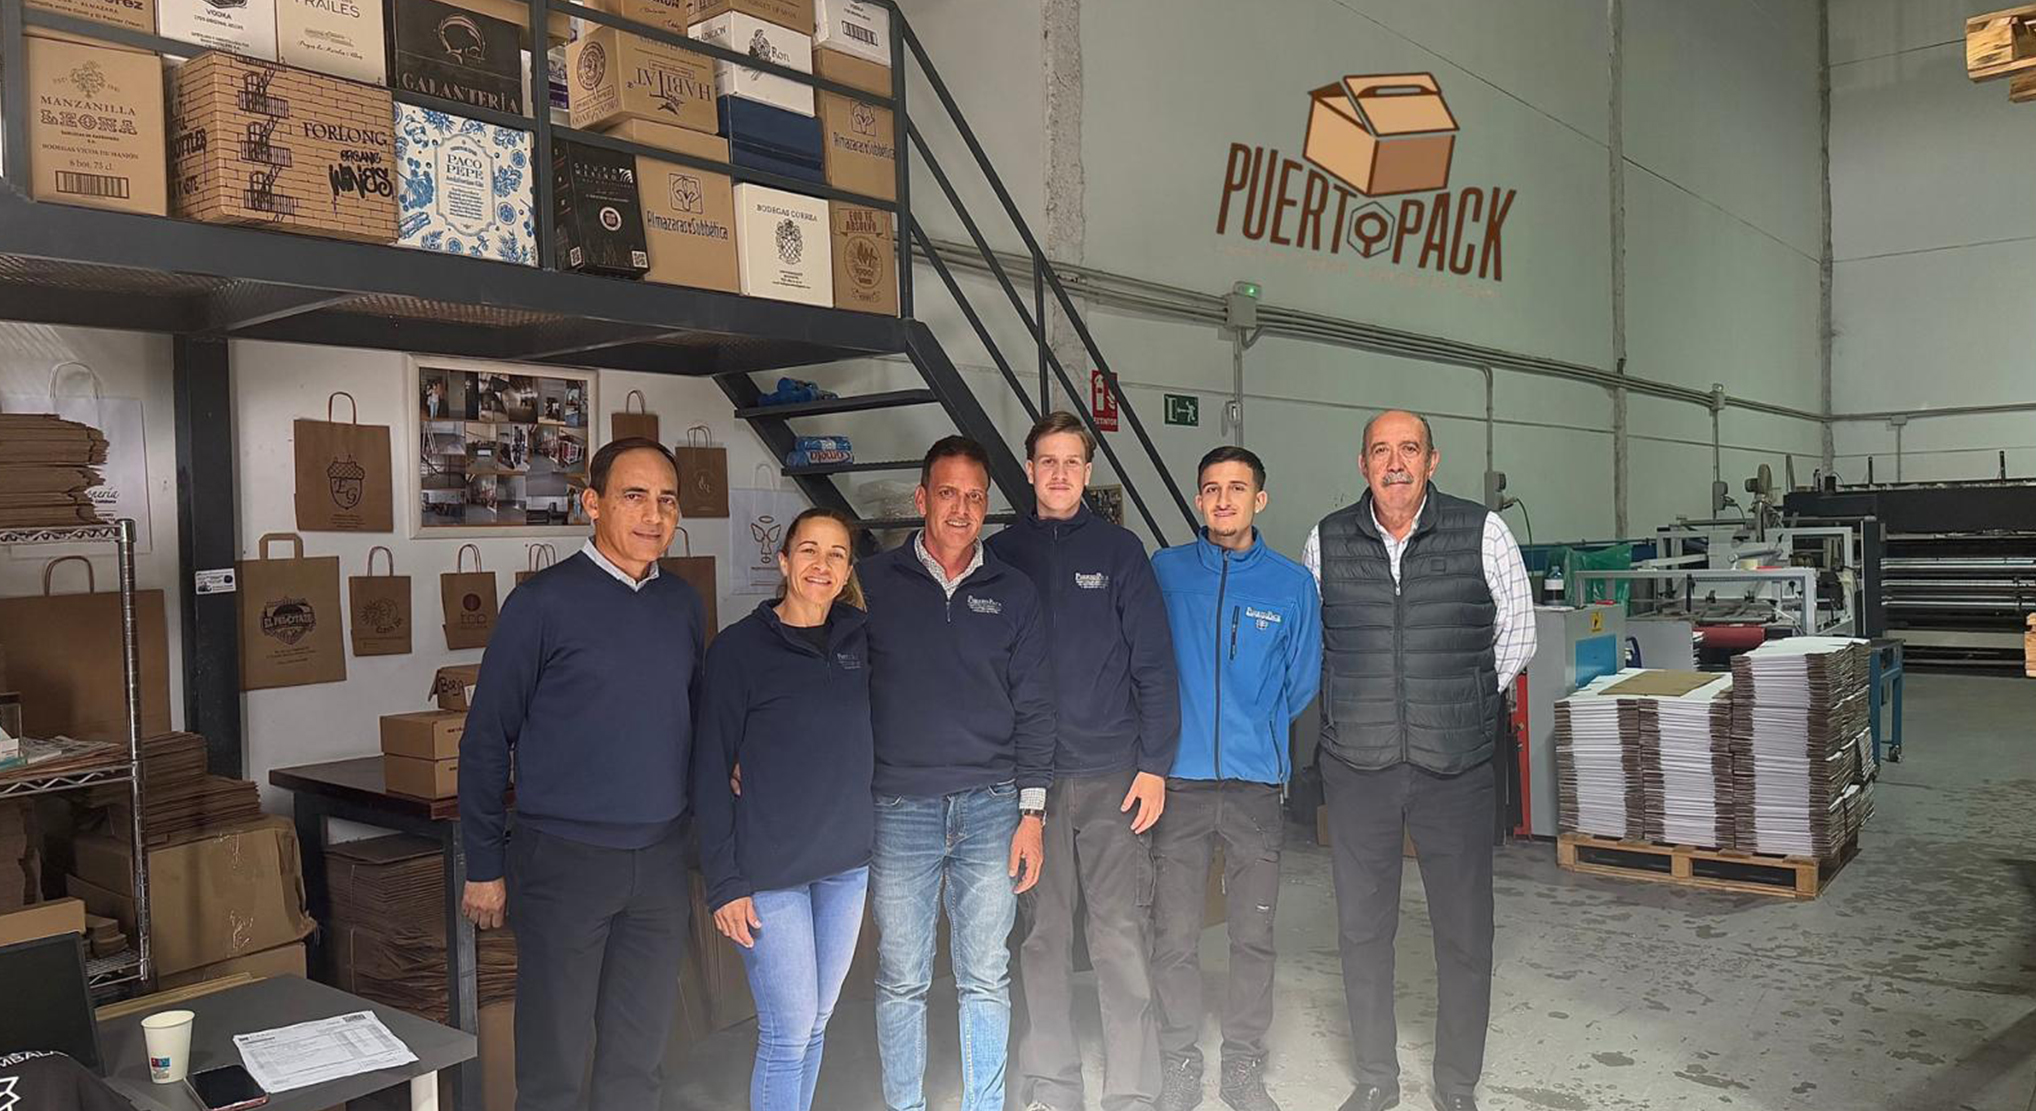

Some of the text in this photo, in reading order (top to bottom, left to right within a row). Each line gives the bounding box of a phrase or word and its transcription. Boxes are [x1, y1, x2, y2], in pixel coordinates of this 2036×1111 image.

[206, 8, 233, 20] VODKA
[294, 0, 360, 18] RAILES
[772, 46, 790, 62] Ron
[636, 66, 712, 101] HABITAT
[40, 96, 136, 116] MANZANILLA
[40, 109, 138, 136] LEONA
[302, 122, 387, 146] FORLONG
[447, 153, 482, 170] PACO
[446, 164, 484, 181] PEPE
[756, 204, 790, 217] BODEGAS
